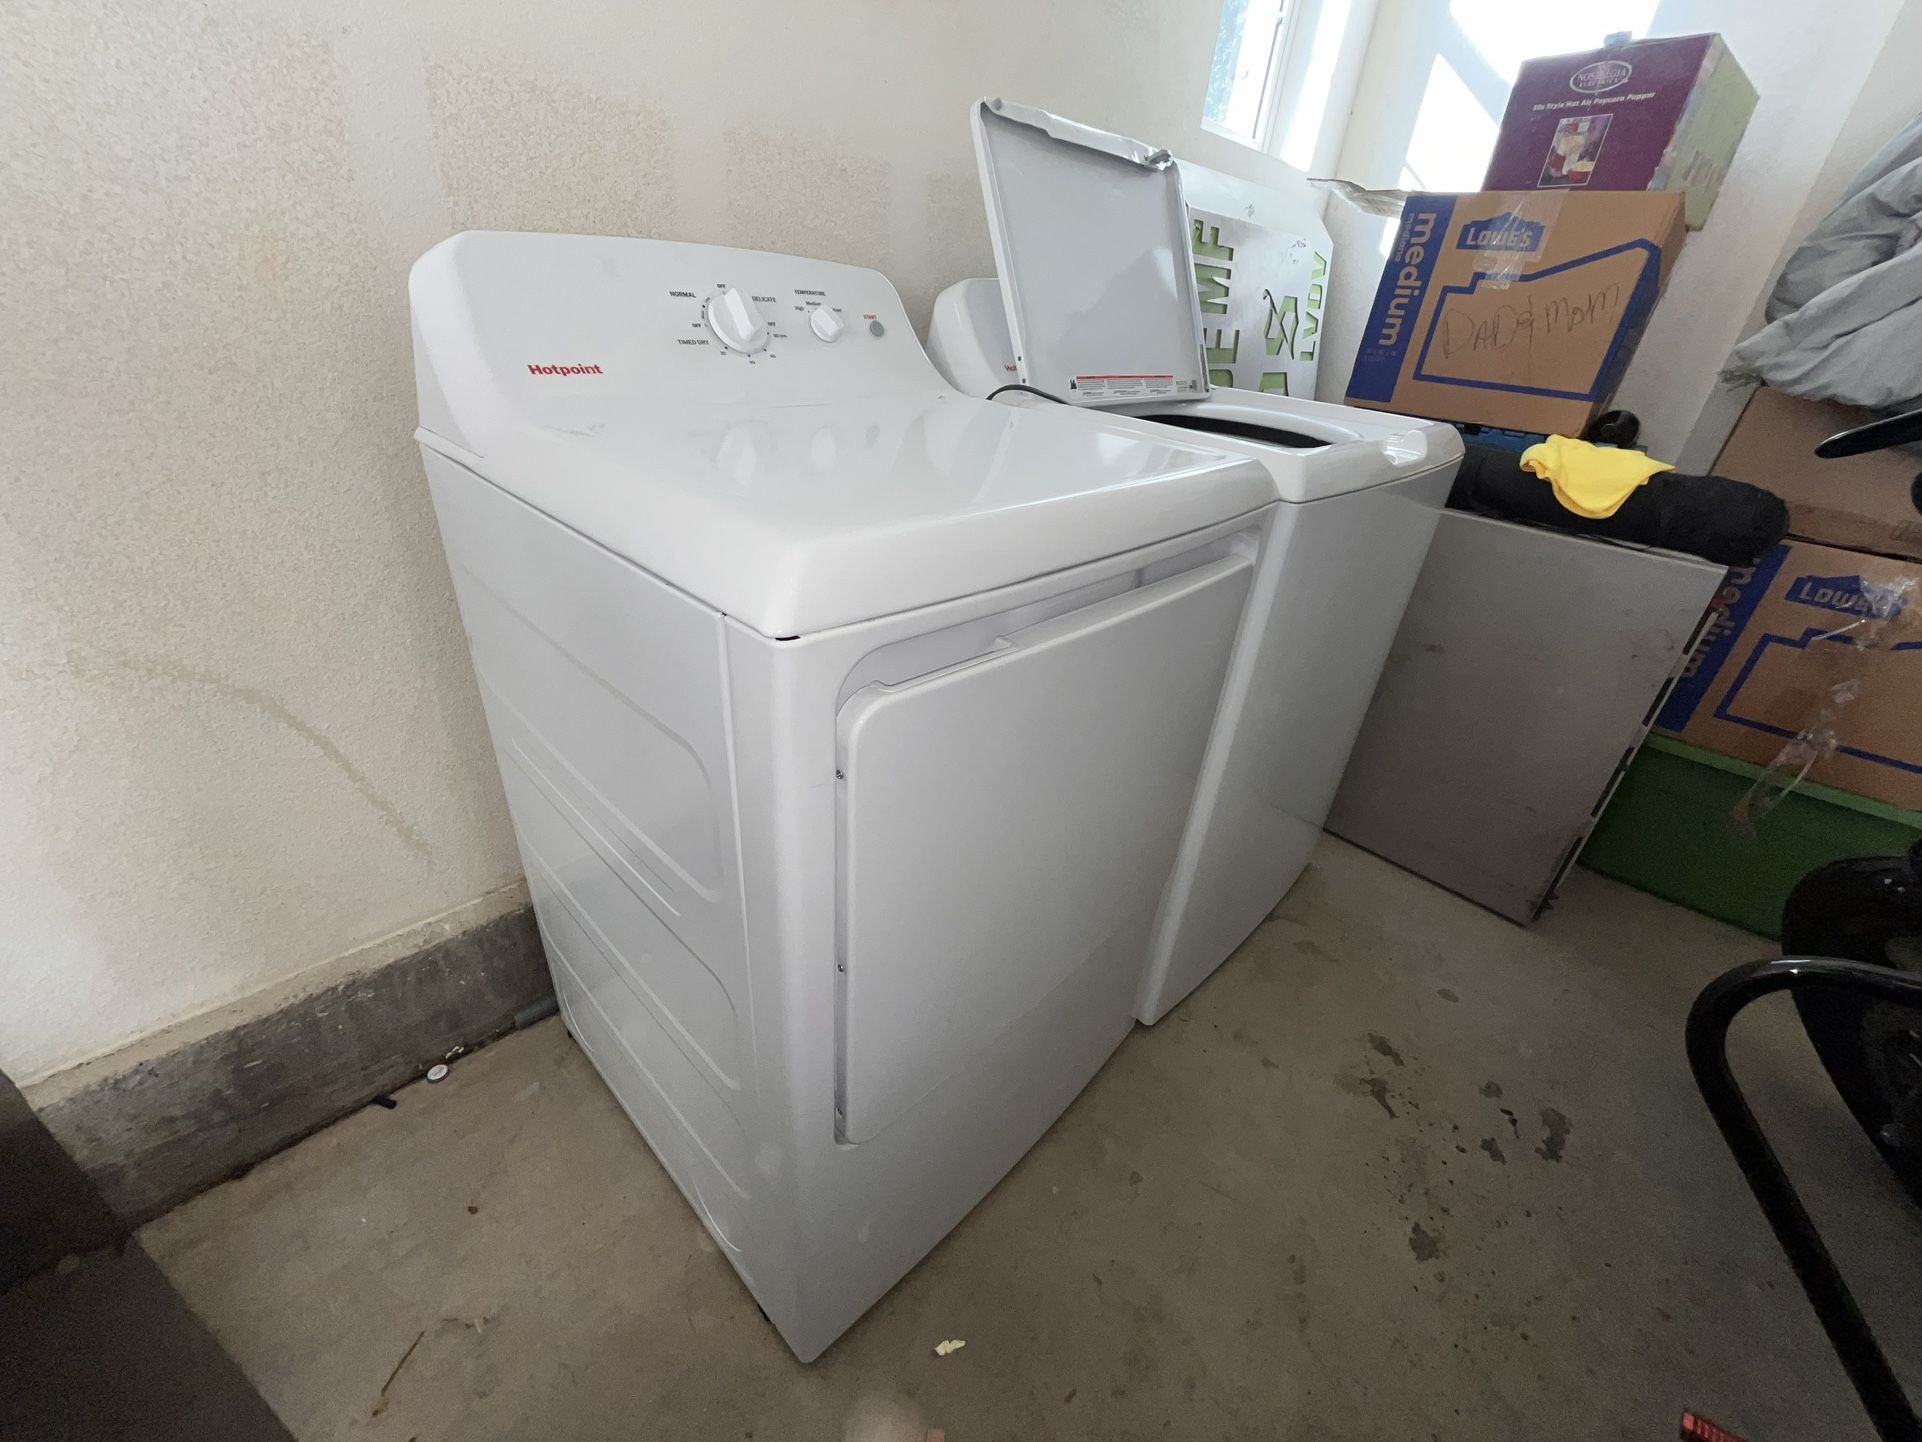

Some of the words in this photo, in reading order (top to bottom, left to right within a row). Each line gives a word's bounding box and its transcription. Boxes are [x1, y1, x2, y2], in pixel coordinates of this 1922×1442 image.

[1593, 96, 1625, 105] Popcorn
[1378, 213, 1437, 346] medium
[527, 363, 604, 376] Hotpoint
